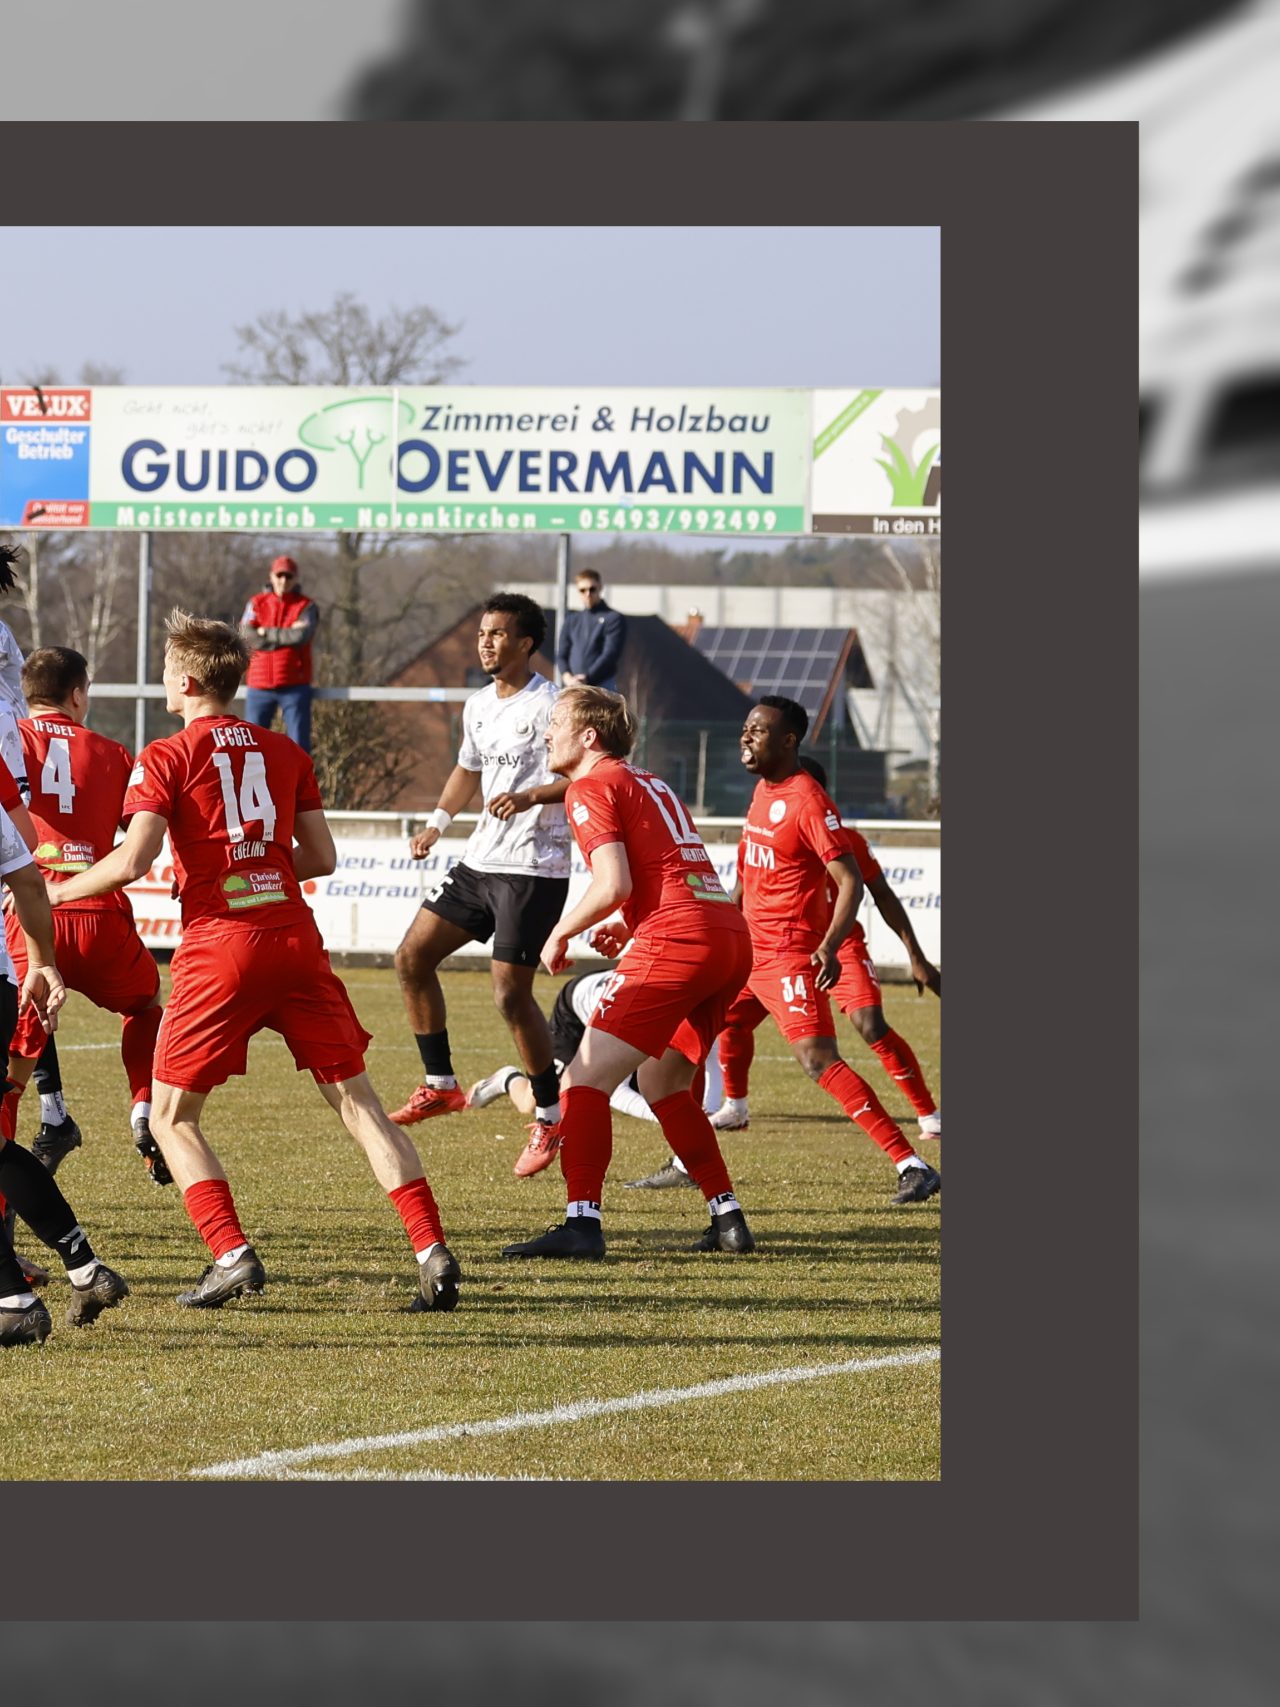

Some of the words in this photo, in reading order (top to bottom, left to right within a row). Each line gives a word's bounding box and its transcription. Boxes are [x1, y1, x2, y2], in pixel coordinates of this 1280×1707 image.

[420, 404, 579, 432] Zimmerei
[591, 405, 615, 432] &
[630, 404, 771, 433] Holzbau
[6, 427, 86, 445] Geschulter
[18, 444, 74, 459] Betrieb
[120, 438, 318, 493] GUIDO
[394, 438, 774, 495] OEVERMANN
[116, 506, 316, 527] Meisterbetrieb
[357, 506, 536, 528] Neuenkirchen
[578, 508, 777, 532] 05493/992499
[873, 516, 890, 533] In
[892, 516, 925, 533] den
[41, 737, 76, 814] 4
[211, 751, 277, 844] 14
[634, 776, 704, 845] 12
[232, 841, 267, 861] EBELING
[389, 855, 440, 870] und
[249, 872, 281, 883] Christof
[602, 971, 626, 1002] 12
[780, 974, 808, 1003] 34
